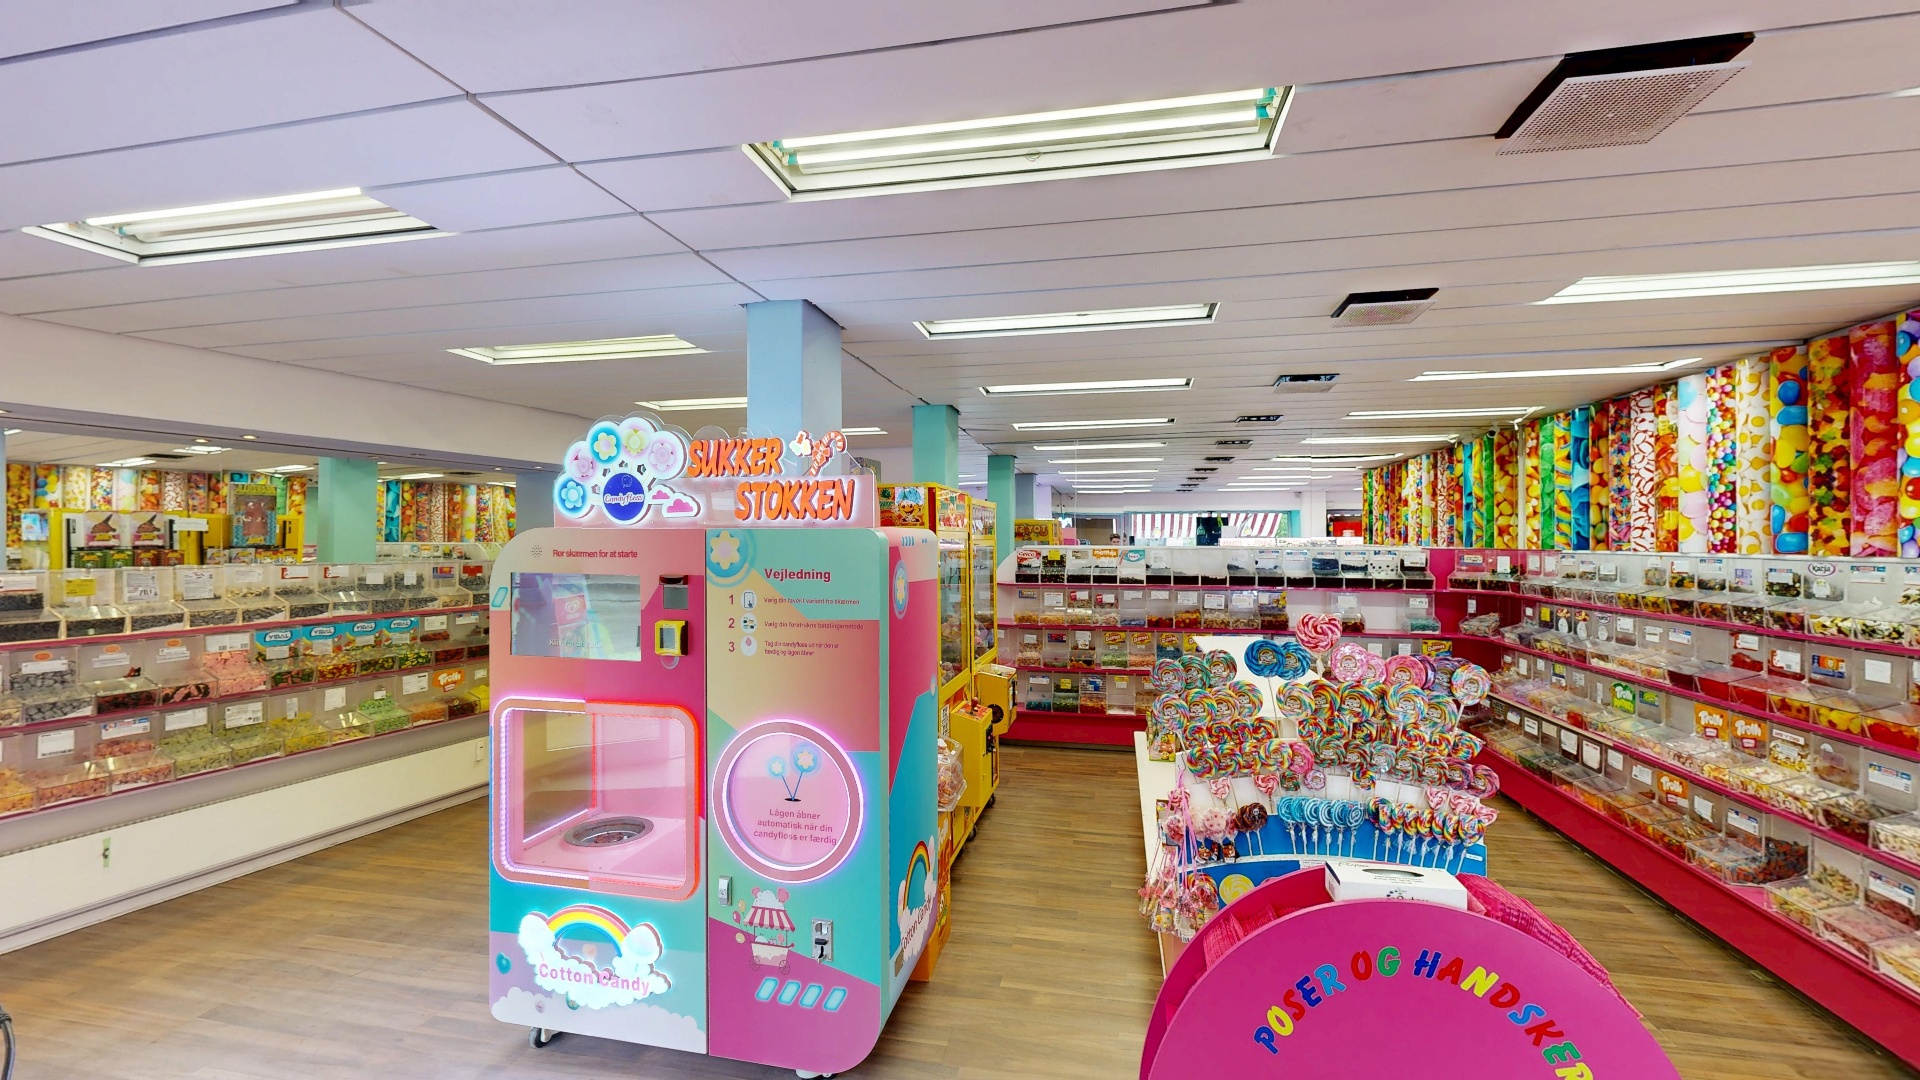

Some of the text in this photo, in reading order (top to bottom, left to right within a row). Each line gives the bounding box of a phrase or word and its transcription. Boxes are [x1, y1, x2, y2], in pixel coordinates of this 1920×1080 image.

[687, 437, 784, 478] SUKKER
[604, 491, 644, 506] Candyfloss
[735, 479, 855, 522] STOKKEN
[599, 549, 608, 558] for
[609, 550, 617, 558] at
[617, 550, 638, 558] starte
[764, 568, 831, 583] Vejledning
[729, 594, 735, 605] 1
[728, 618, 735, 629] 2
[728, 641, 736, 653] 3
[769, 809, 821, 820] Lågen åbner
[757, 819, 833, 832] automatisk når din
[753, 830, 798, 841] candyfloss
[810, 834, 837, 846] færdig
[539, 963, 650, 996] Cotton Candy
[1253, 946, 1595, 1080] POSER OG HANDSKER
